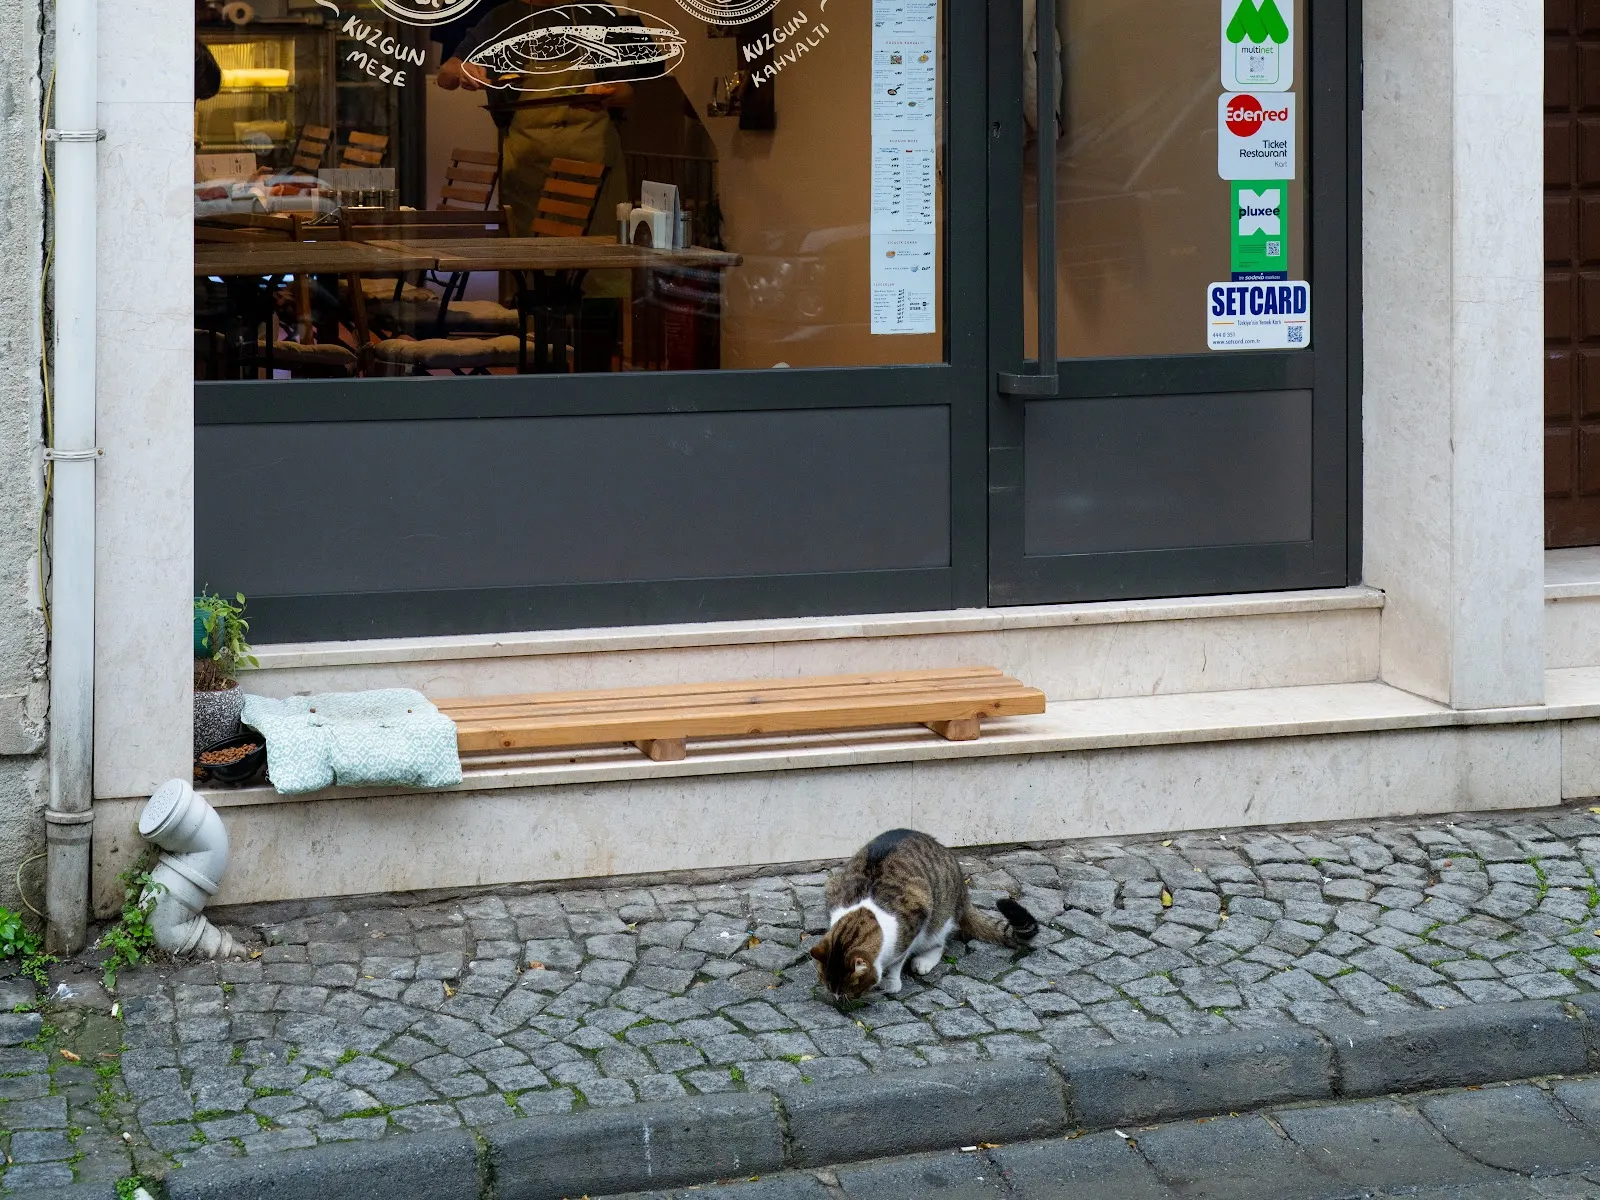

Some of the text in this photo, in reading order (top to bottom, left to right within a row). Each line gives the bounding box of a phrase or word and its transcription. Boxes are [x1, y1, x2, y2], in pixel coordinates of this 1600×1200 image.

[342, 15, 426, 67] KUZGUN
[742, 10, 808, 62] KUZGUN
[751, 22, 830, 89] KAHVALTI
[1241, 45, 1274, 54] multinet
[346, 50, 407, 87] MEZE
[1226, 107, 1288, 122] Edenred
[1239, 149, 1288, 158] Restaurant
[1262, 140, 1288, 149] Ticket
[1238, 206, 1281, 220] pluxee
[1212, 286, 1306, 316] SETCARD
